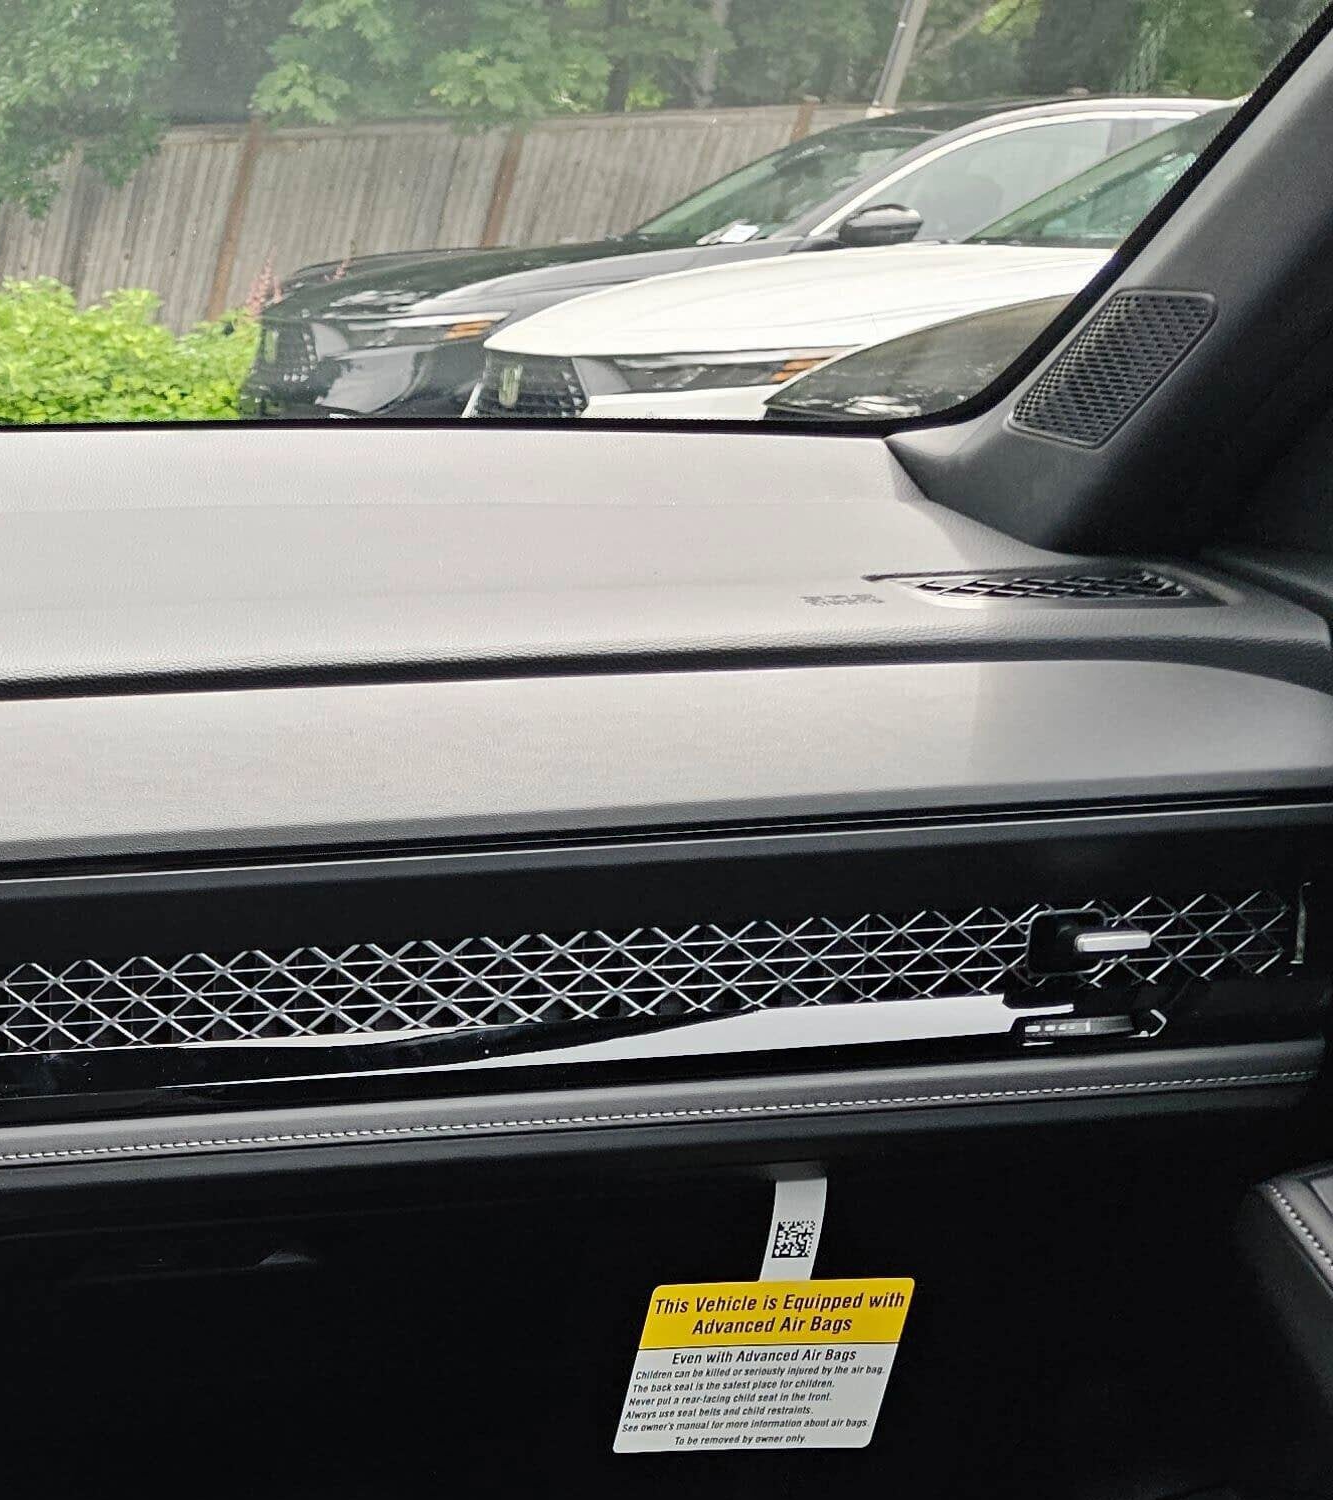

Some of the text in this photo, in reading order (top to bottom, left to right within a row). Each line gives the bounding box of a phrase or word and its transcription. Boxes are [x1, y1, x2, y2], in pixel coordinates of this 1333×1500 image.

[655, 1292, 905, 1314] This Vehicle is Equipped with
[692, 1316, 853, 1335] Advanced Air Bags
[672, 1349, 857, 1365] Even with Advanced Air Bags
[636, 1370, 672, 1380] Children
[674, 1370, 690, 1378] can
[693, 1369, 703, 1377] be
[705, 1368, 731, 1377] killed
[744, 1367, 785, 1376] seriously
[787, 1366, 820, 1376] injured
[821, 1366, 831, 1375] by
[834, 1365, 848, 1374] the
[866, 1365, 885, 1375] bag.
[633, 1379, 835, 1393] The back seat is the safest place for children.
[629, 1398, 655, 1406] Never
[656, 1396, 671, 1408] put
[682, 1394, 731, 1405] rear-facing
[733, 1393, 755, 1403] child
[757, 1393, 777, 1402] seat
[780, 1393, 789, 1401] in
[791, 1392, 805, 1401] the
[808, 1392, 832, 1401] front.
[625, 1405, 813, 1420] Always use seat belts and child restraints.
[622, 1419, 869, 1432] See owner's manual for more information about air bags.
[675, 1436, 684, 1445] To
[687, 1436, 698, 1445] be
[700, 1435, 740, 1444] removed
[742, 1435, 753, 1445] by
[755, 1435, 782, 1443] owner
